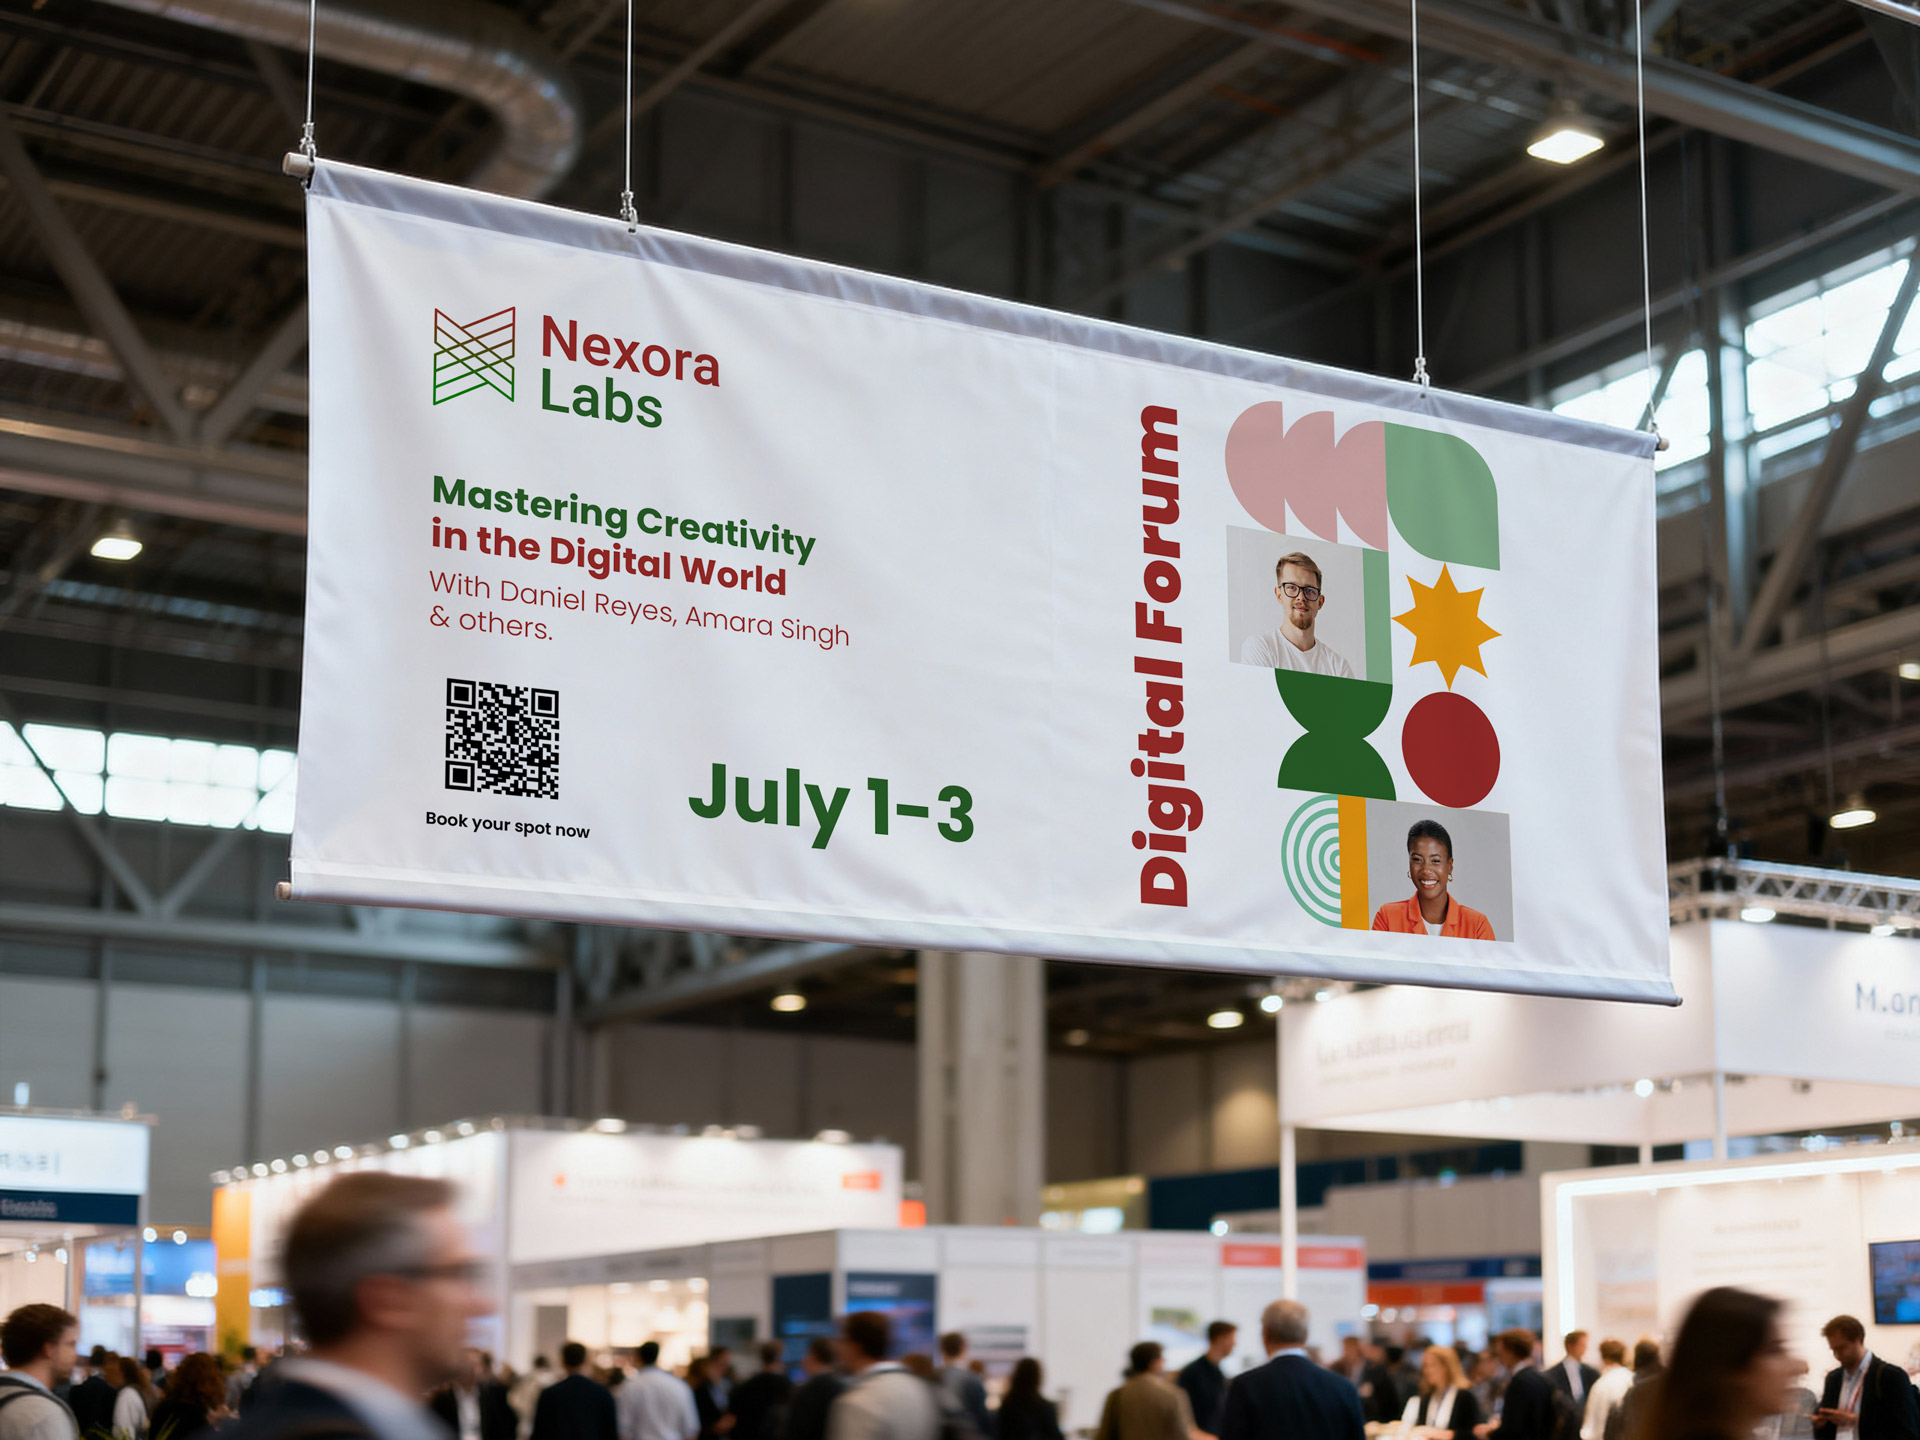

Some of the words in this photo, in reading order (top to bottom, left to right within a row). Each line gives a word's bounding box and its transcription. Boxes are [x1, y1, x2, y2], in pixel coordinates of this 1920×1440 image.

[542, 314, 720, 387] Nexora
[541, 367, 663, 429] Labs
[432, 516, 467, 552] in
[477, 526, 541, 561] the
[550, 536, 671, 580] Digital
[679, 555, 786, 596] World
[433, 475, 628, 540] Mastering
[636, 507, 817, 566] Creativity
[1134, 404, 1183, 645] Forum
[429, 570, 490, 599] With
[500, 579, 585, 612] Daniel
[595, 592, 678, 628] Reyes,
[685, 605, 773, 637] Amara
[781, 618, 850, 651] Singh
[429, 605, 450, 628] &
[459, 610, 553, 641] others.
[688, 762, 851, 850] July
[1131, 655, 1204, 908] Digital
[425, 811, 469, 828] Book
[471, 817, 511, 833] your
[514, 821, 552, 838] spot
[555, 825, 591, 839] now
